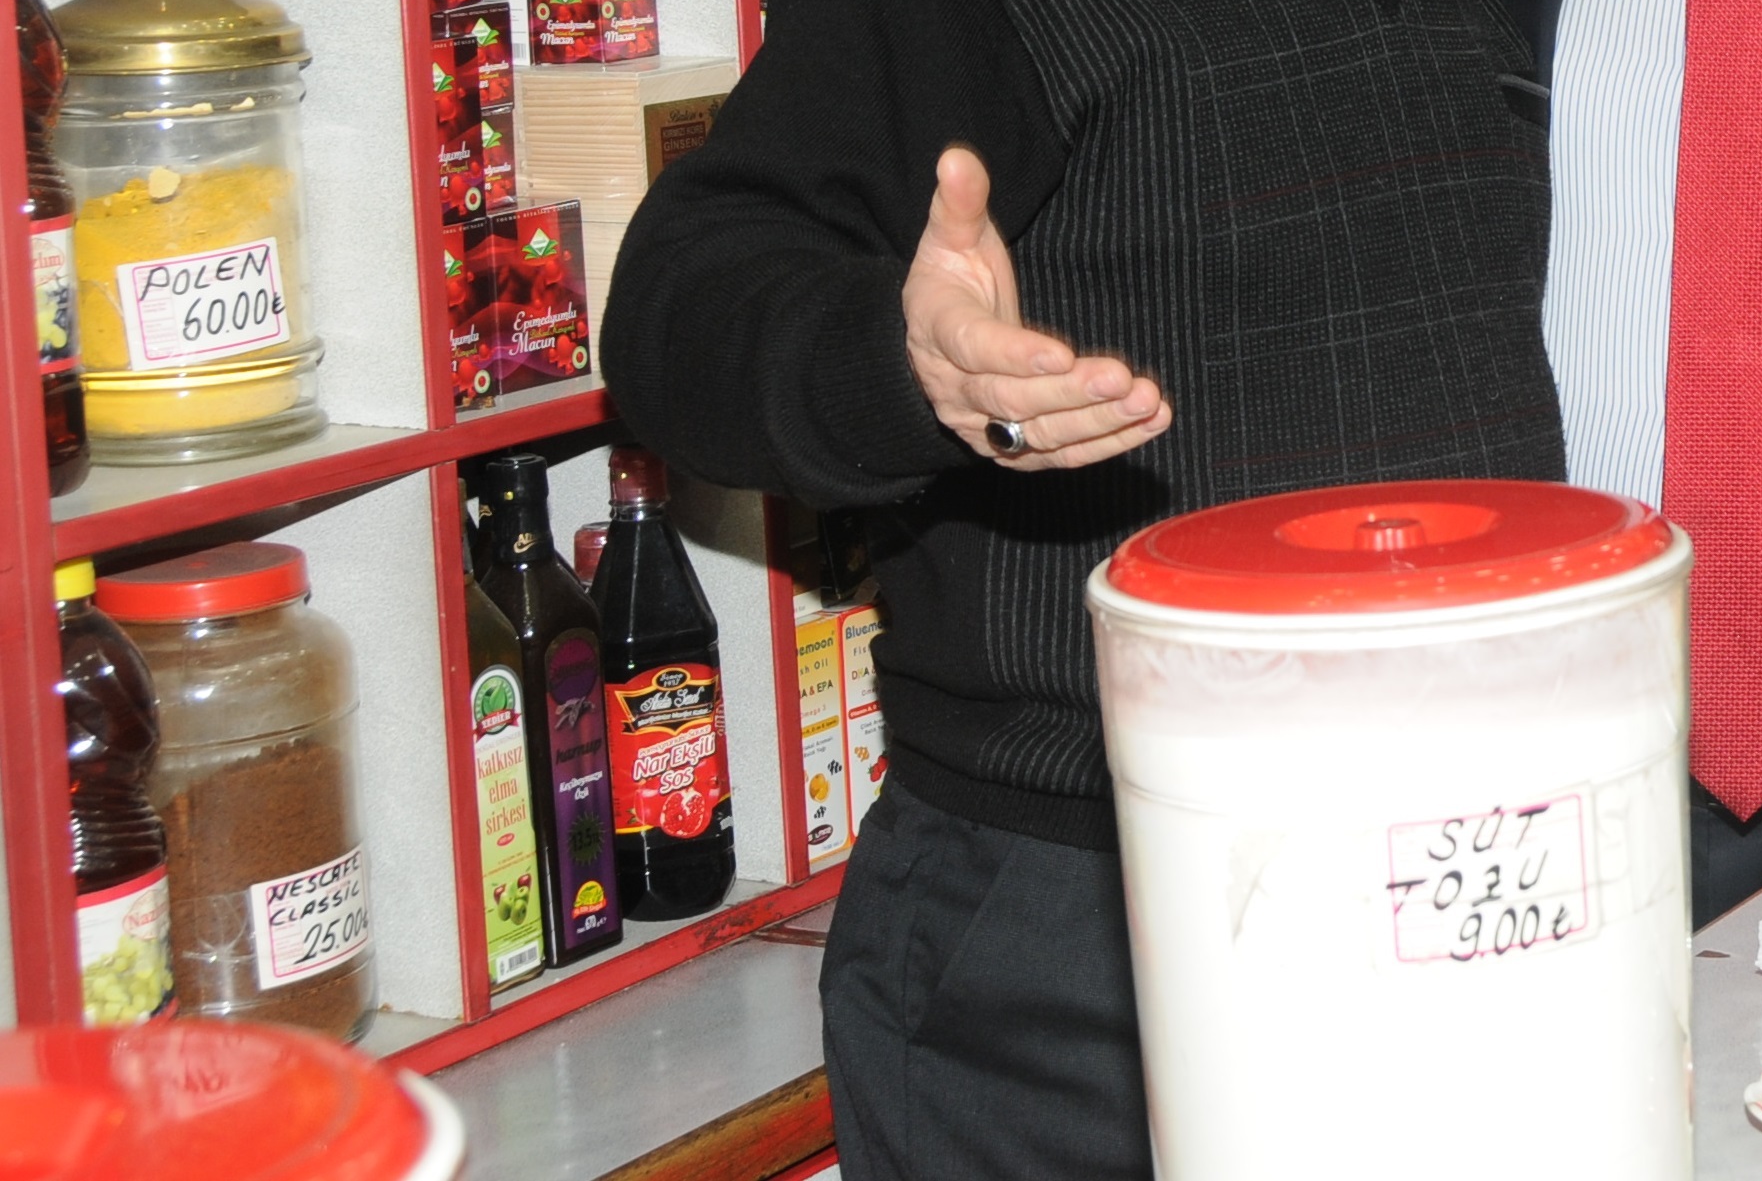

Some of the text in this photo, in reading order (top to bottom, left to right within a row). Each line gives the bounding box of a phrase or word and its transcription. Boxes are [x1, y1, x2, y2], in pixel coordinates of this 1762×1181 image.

[138, 244, 271, 302] POLEN
[816, 681, 835, 694] EPA
[476, 744, 524, 780] katkısız
[633, 753, 671, 781] Nar
[488, 776, 519, 805] elma
[485, 798, 527, 836] sirkesi
